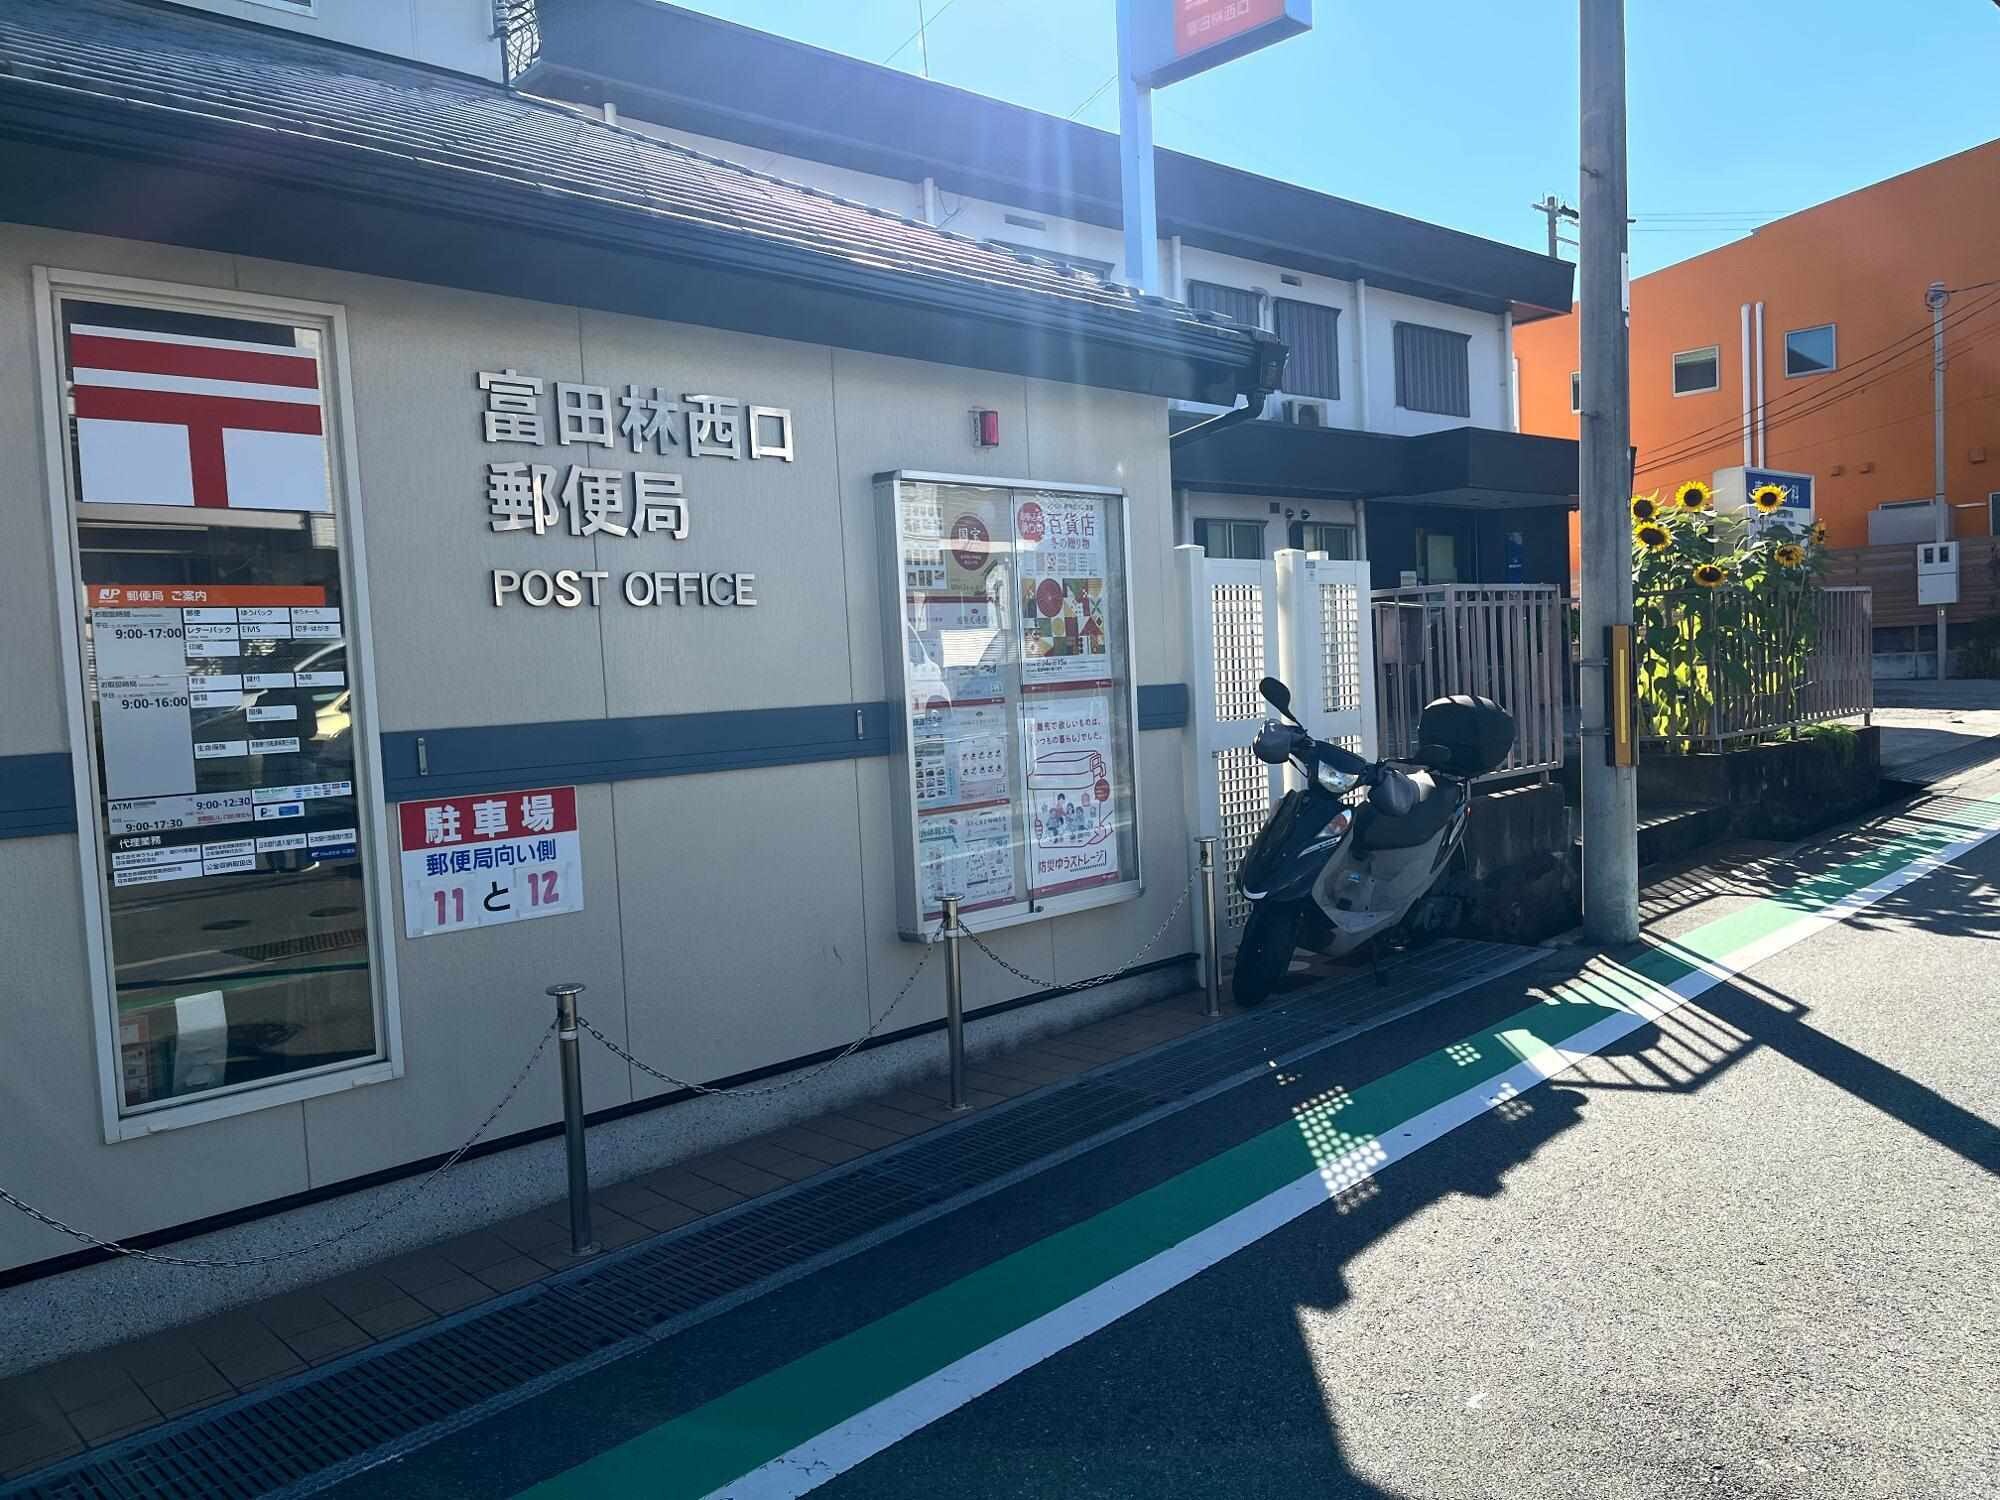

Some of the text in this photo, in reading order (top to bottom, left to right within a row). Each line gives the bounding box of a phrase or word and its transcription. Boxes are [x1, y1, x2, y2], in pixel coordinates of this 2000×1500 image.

[478, 368, 794, 462] 富田林西口
[487, 462, 690, 540] 郵便局
[1047, 512, 1096, 537] 百貨店
[493, 569, 758, 607] POST OFFICE
[115, 628, 182, 640] 9:00-17:00
[241, 625, 261, 634] EMS
[121, 696, 188, 710] 9:00-16:00
[111, 802, 132, 811] ATM
[424, 794, 555, 845] 駐車場
[125, 818, 183, 832] 9:00-17:30
[426, 838, 557, 878] 郵便局向い側
[433, 870, 560, 926] 11 と 12
